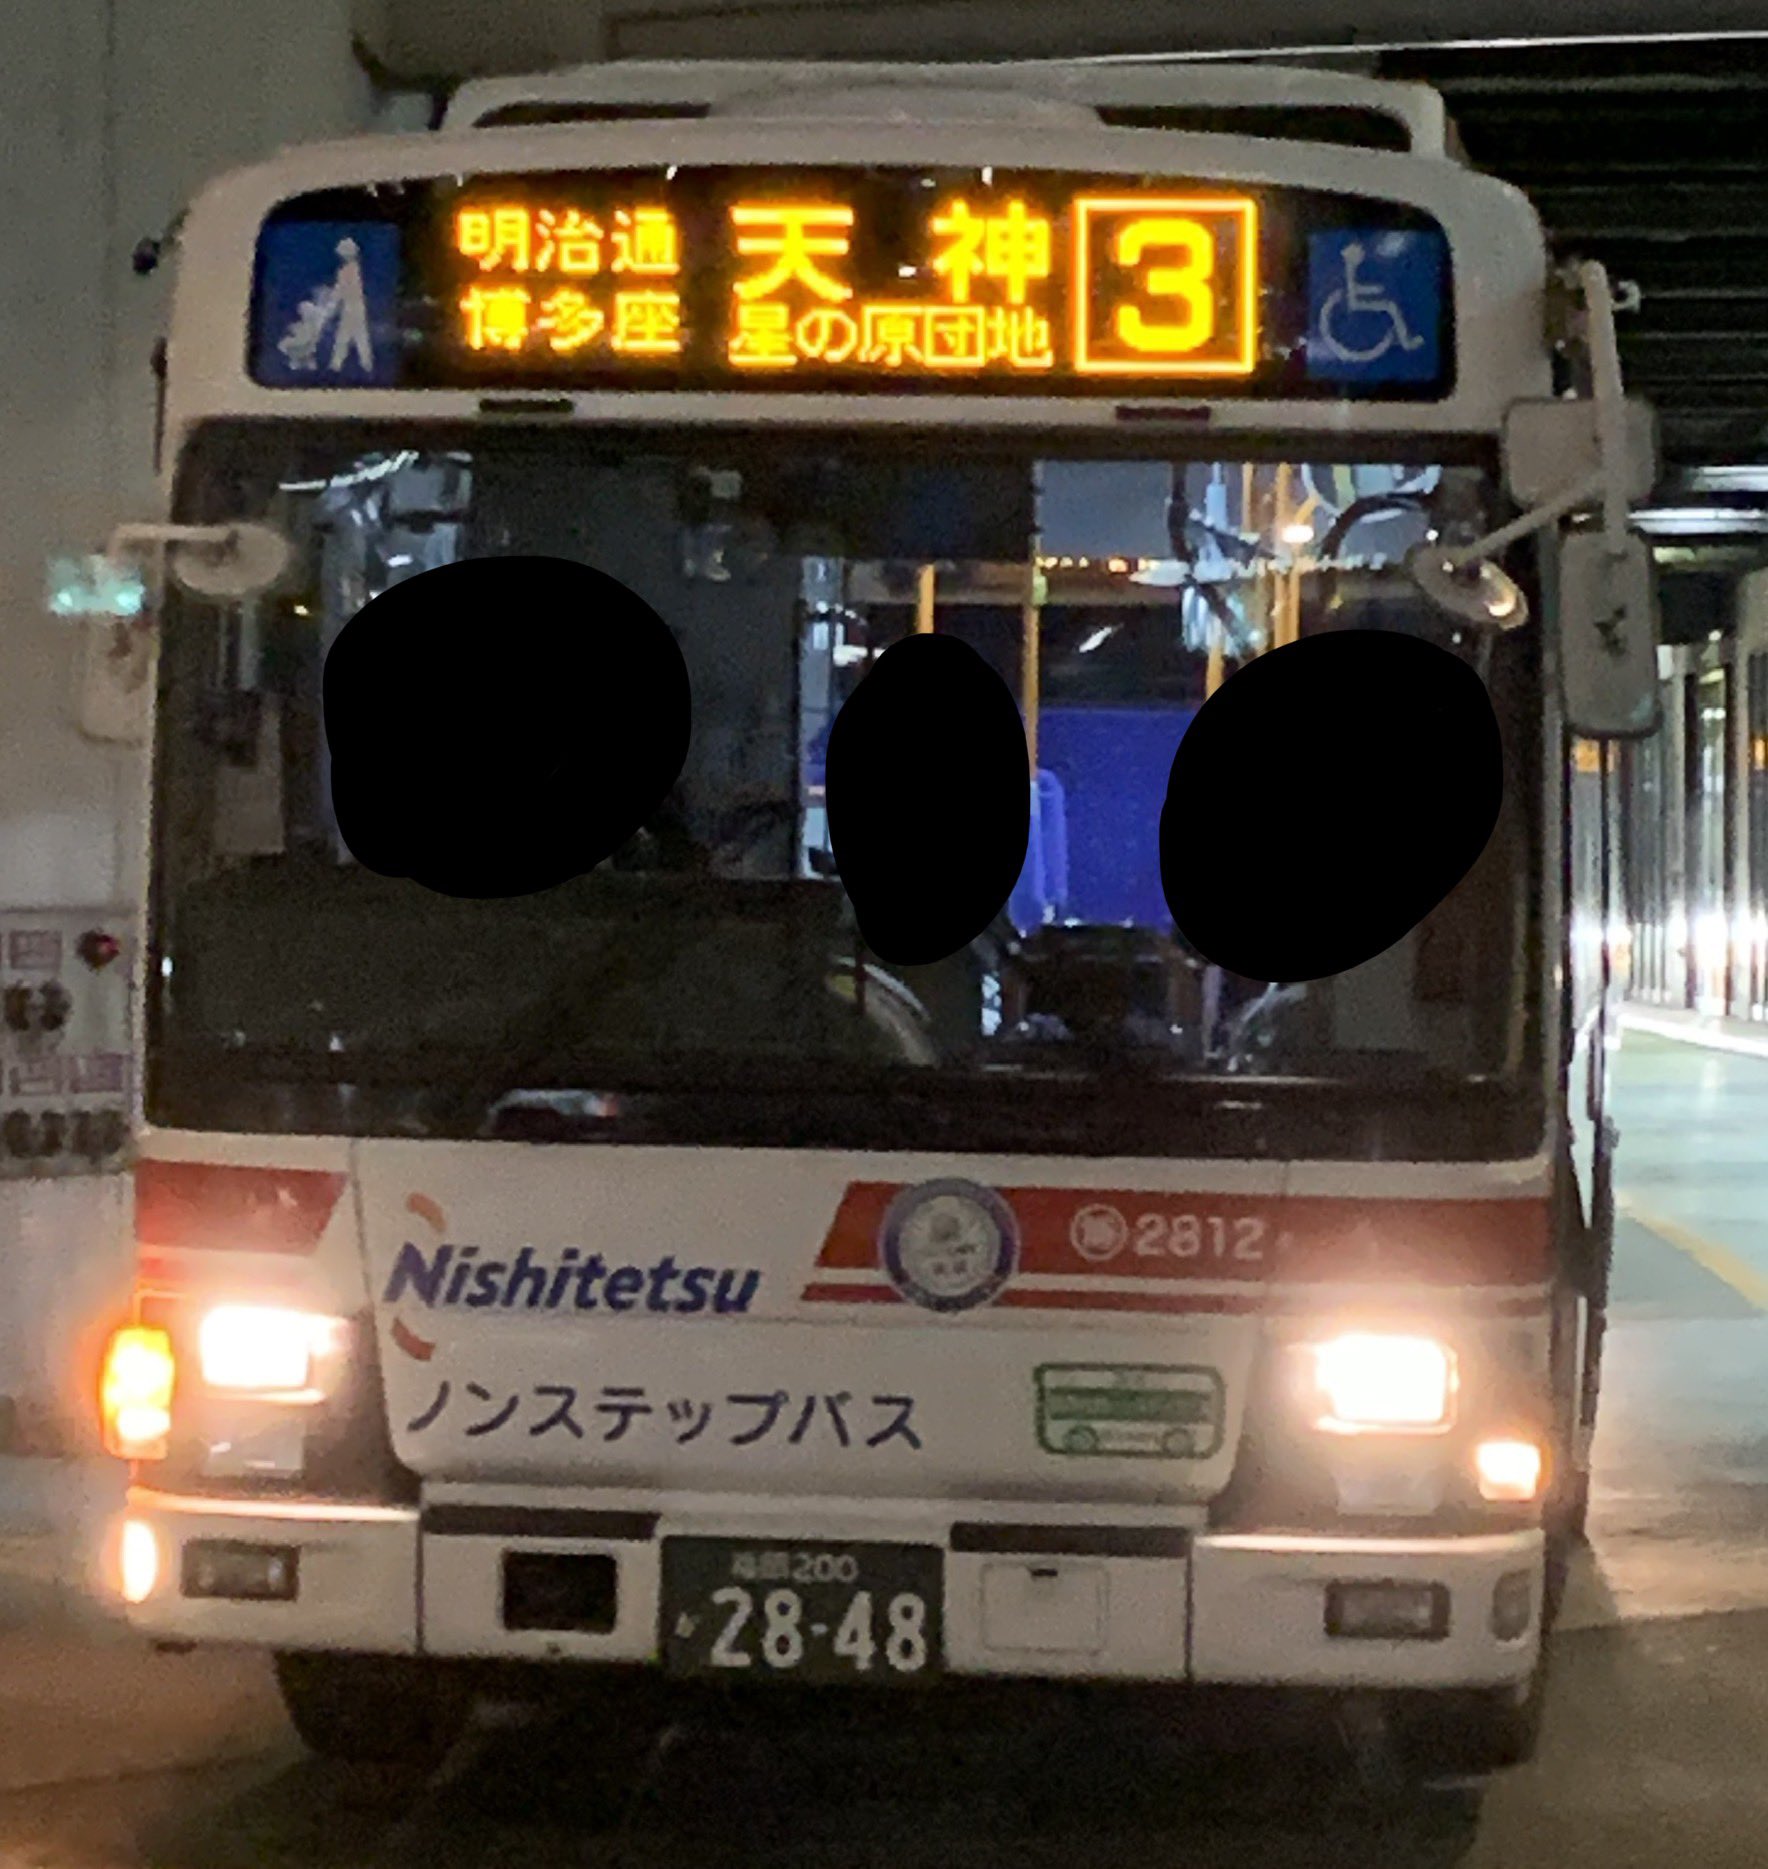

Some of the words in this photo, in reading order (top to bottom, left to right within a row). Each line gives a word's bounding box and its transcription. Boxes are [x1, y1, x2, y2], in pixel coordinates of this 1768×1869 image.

[457, 207, 680, 274] 明治通
[731, 202, 1053, 304] 天神
[460, 287, 682, 353] 博多座
[1115, 217, 1214, 354] 3
[728, 304, 1054, 368] 星の原団地
[1133, 1212, 1266, 1260] 2812
[384, 1242, 761, 1314] Nishitetsu
[407, 1381, 923, 1450] ノンステップバス
[710, 1586, 927, 1672] 28-48
